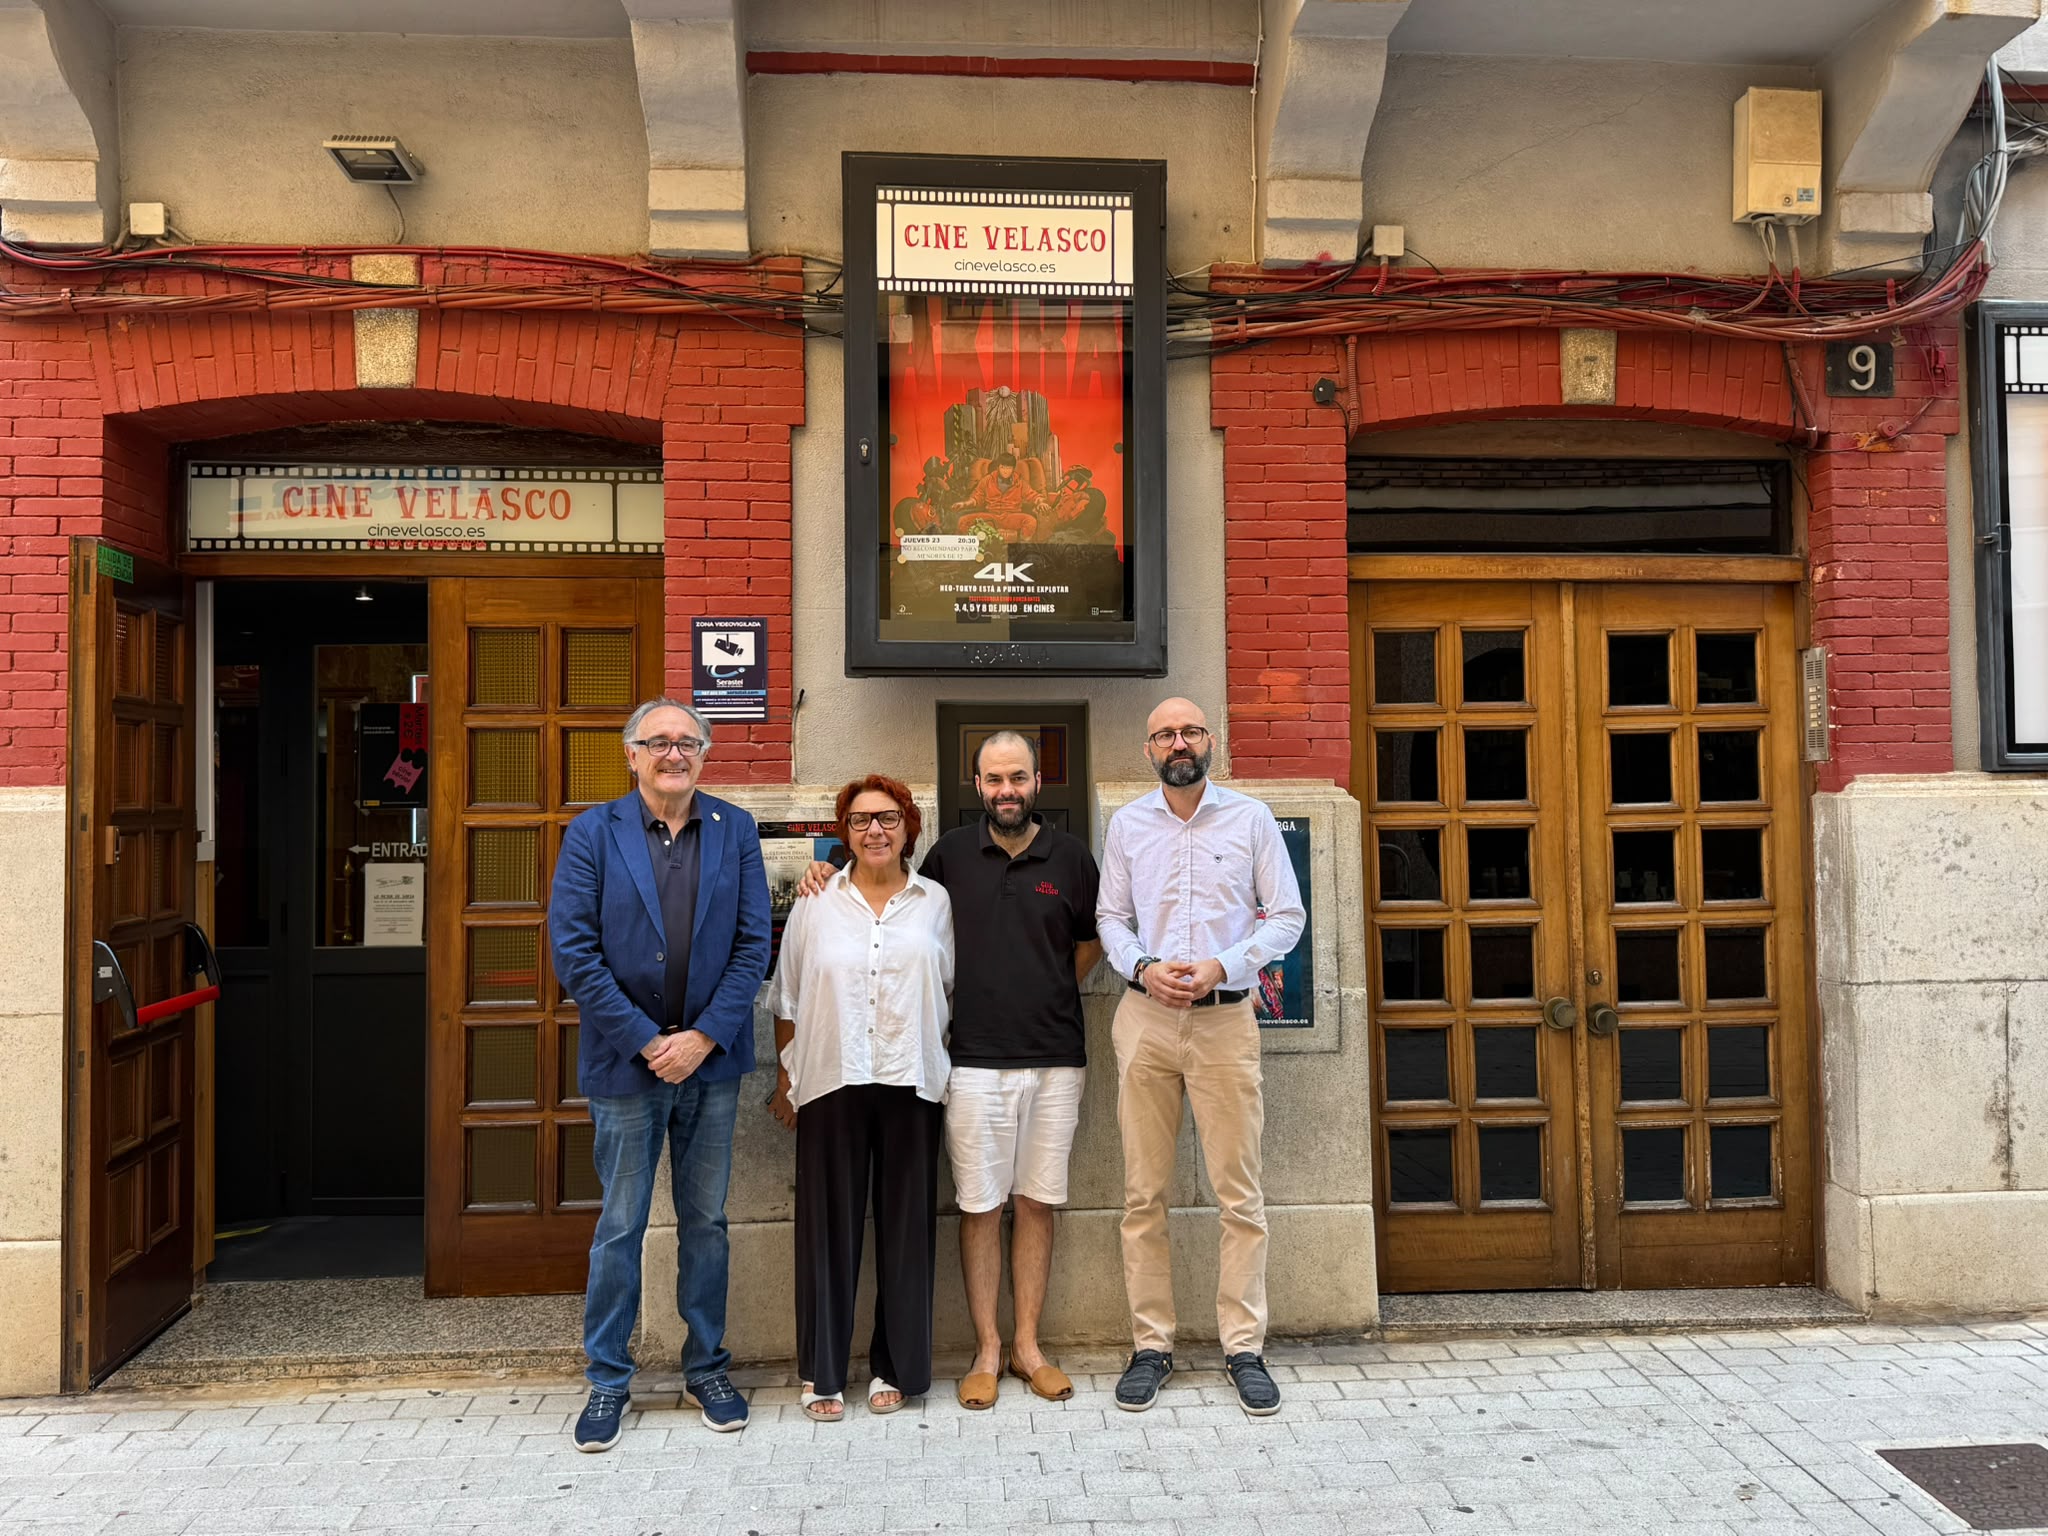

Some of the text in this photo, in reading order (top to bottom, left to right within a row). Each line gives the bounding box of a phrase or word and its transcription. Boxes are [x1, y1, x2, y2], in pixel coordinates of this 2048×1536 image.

[904, 223, 1106, 253] CINE VELASCO
[954, 258, 1056, 274] cinevelasco.es
[1848, 345, 1876, 391] 9
[282, 484, 373, 520] CINE
[394, 486, 572, 521] VELASCO
[367, 523, 486, 538] cinevelasco.es
[973, 562, 1035, 583] 4K
[940, 585, 977, 593] NEO-TOKYO
[979, 585, 995, 593] ESTÁ
[975, 604, 981, 612] Y
[988, 604, 998, 612] DE
[998, 604, 1018, 612] JULIO
[1023, 604, 1033, 613] EN
[1033, 604, 1056, 613] CINES
[787, 823, 837, 832] CINE VELASC
[372, 842, 429, 857] ENTRAD
